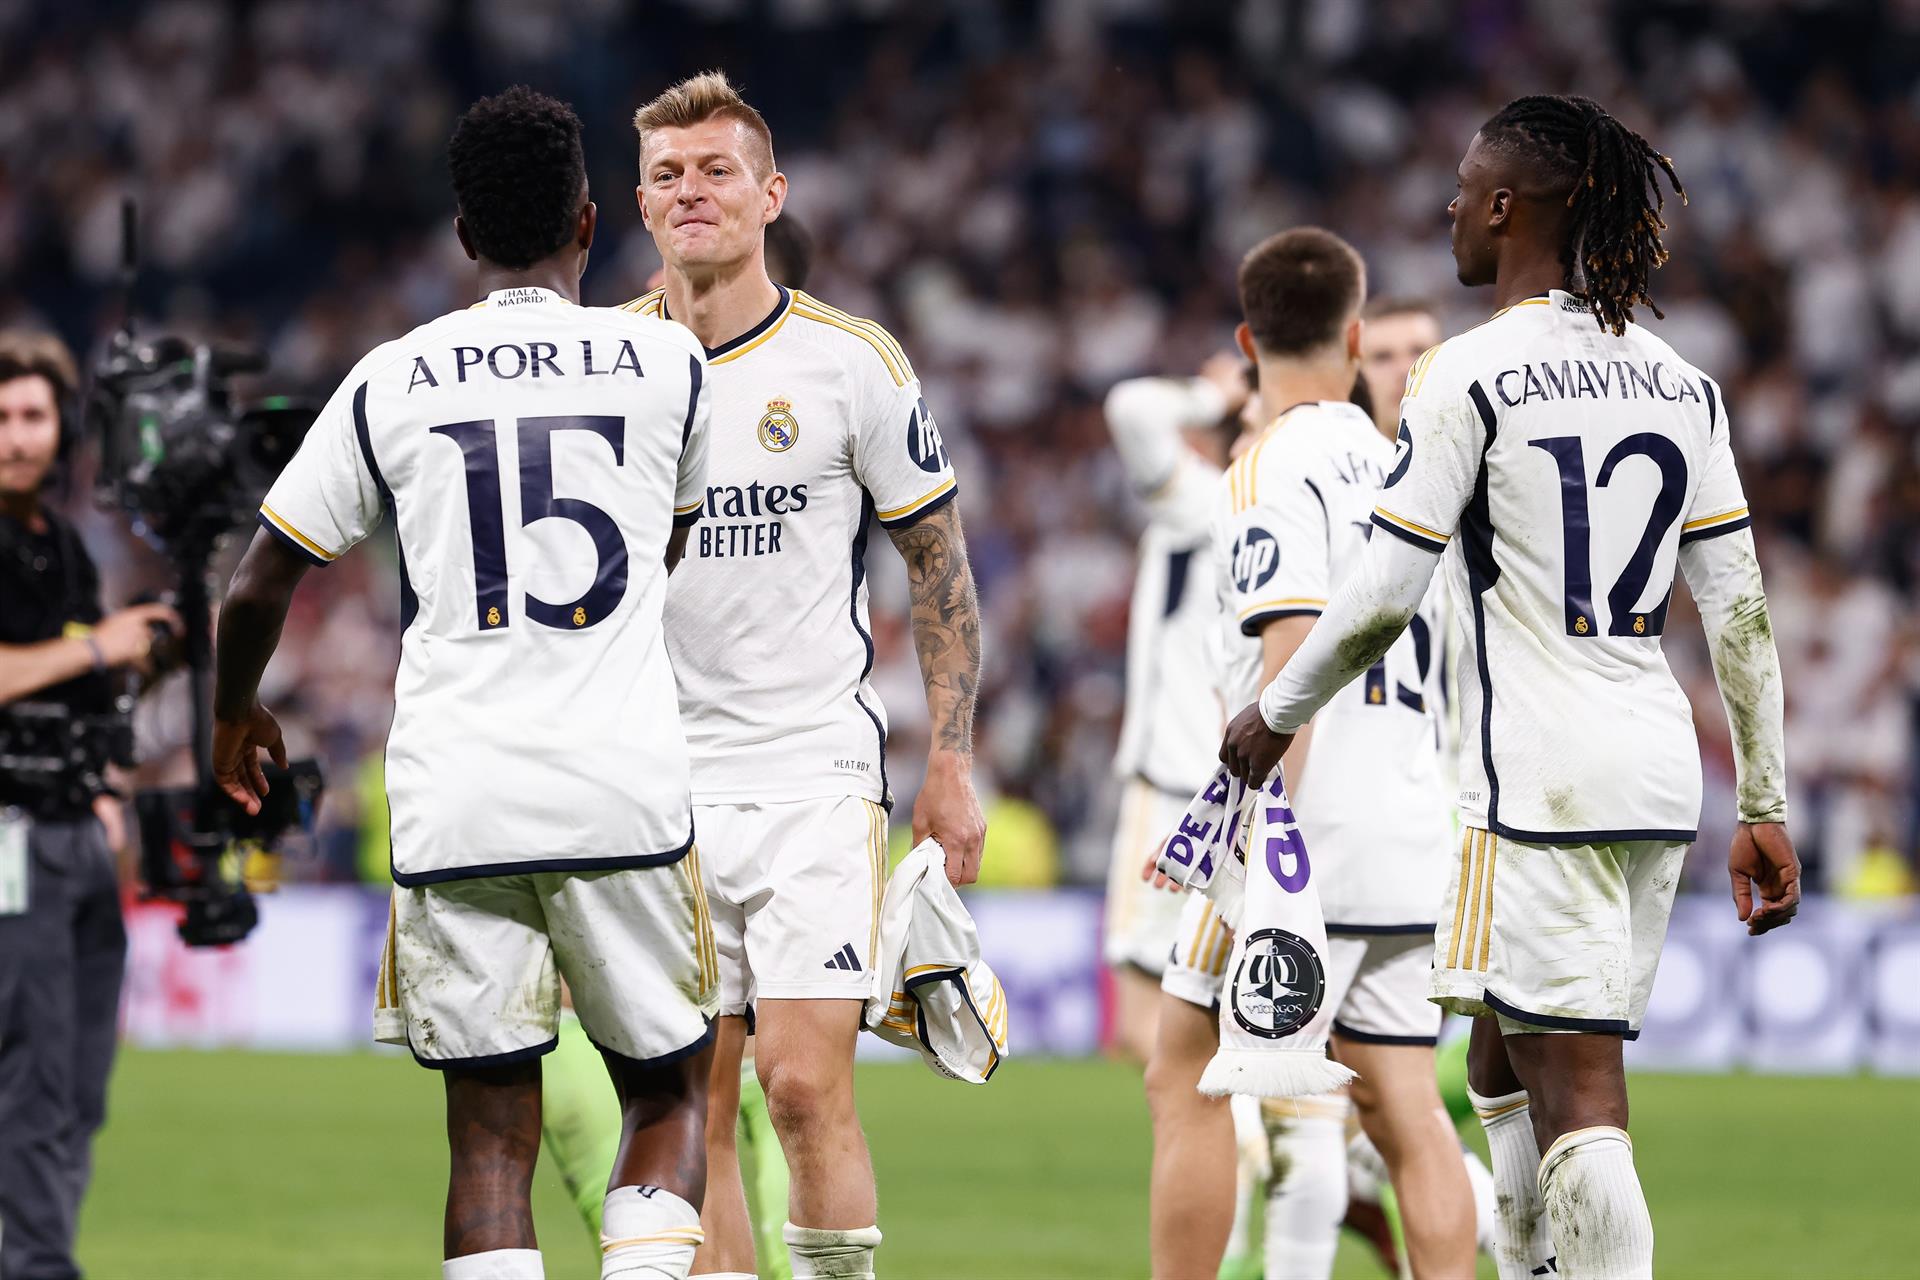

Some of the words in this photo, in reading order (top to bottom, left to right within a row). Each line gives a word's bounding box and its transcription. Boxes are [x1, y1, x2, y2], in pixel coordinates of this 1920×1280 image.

[407, 356, 439, 394] A
[451, 342, 565, 383] POR
[578, 340, 644, 378] LA
[1496, 360, 1701, 407] CAMAVINGA
[429, 415, 629, 631] 15
[699, 479, 808, 519] rates
[699, 522, 782, 559] BETTER
[1528, 432, 1689, 637] 12
[1165, 812, 1212, 868] DE
